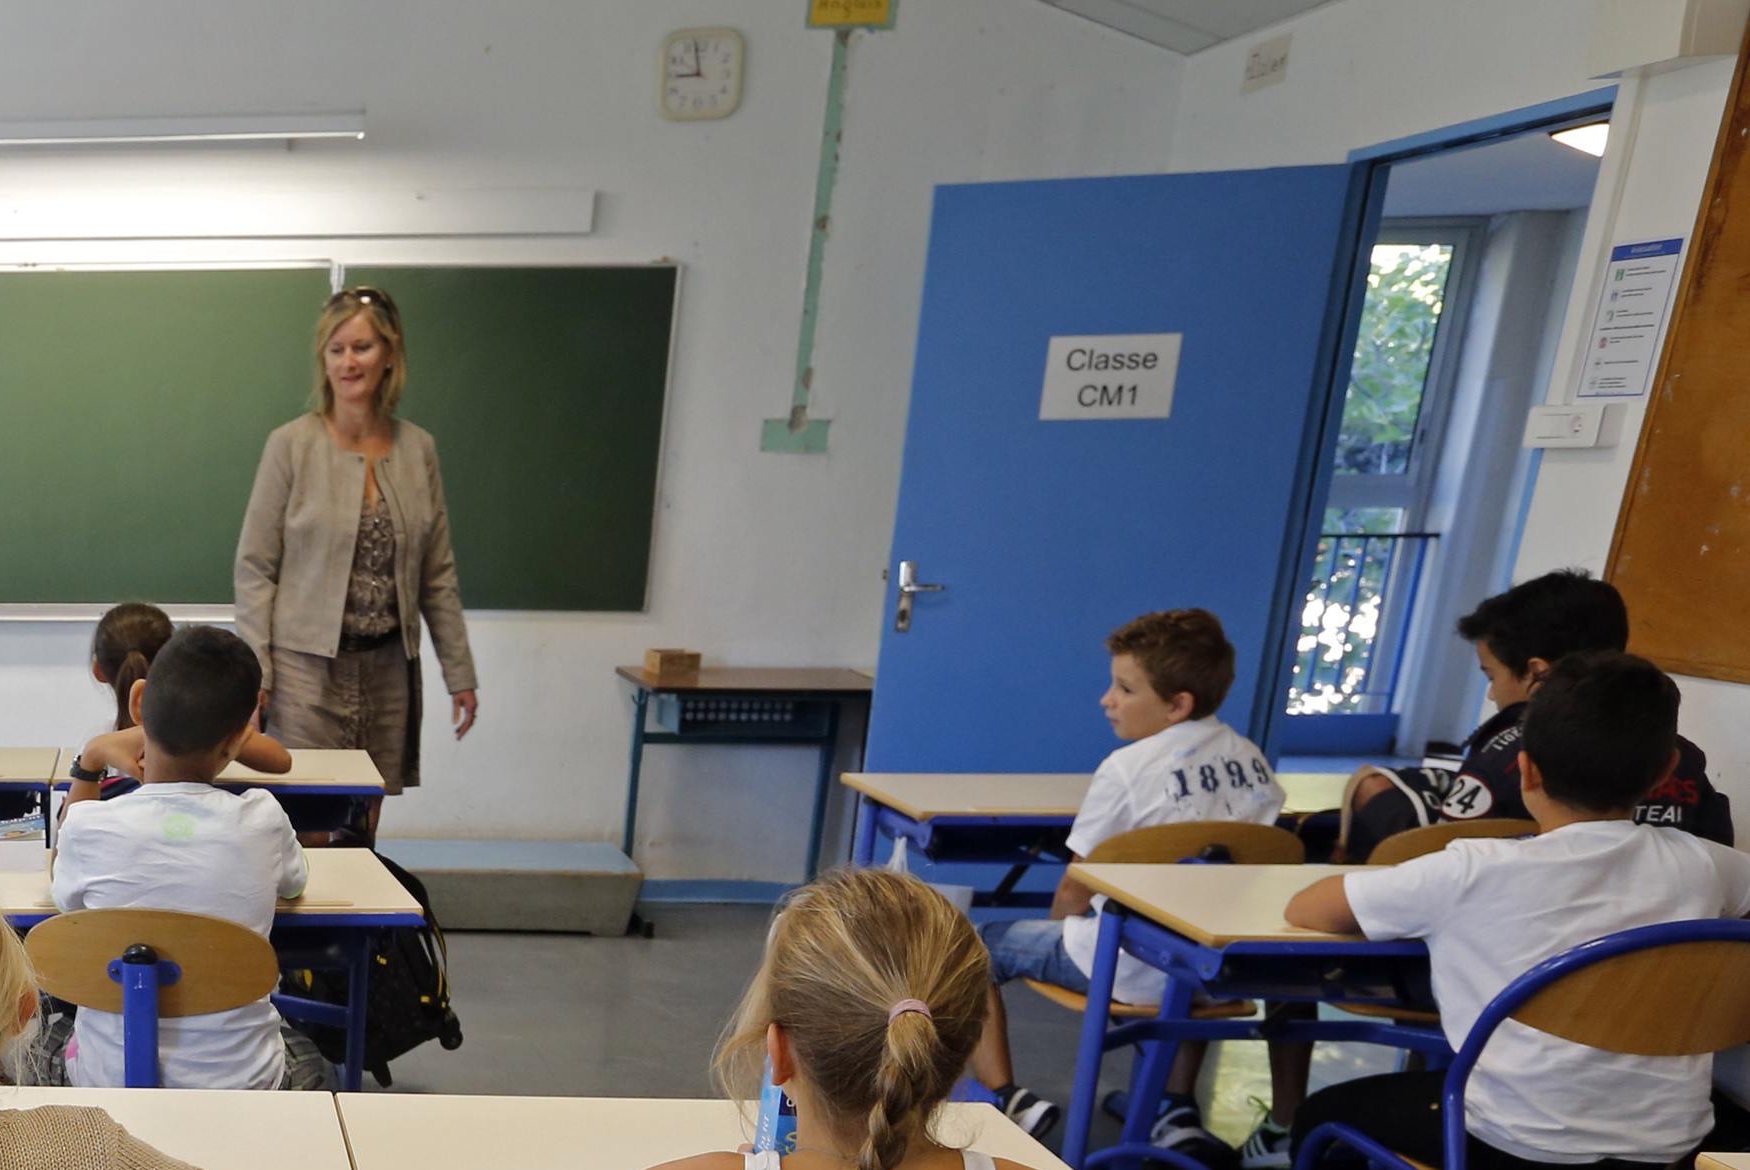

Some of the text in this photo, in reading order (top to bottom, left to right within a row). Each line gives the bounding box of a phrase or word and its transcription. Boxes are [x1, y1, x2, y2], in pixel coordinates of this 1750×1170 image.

[1066, 348, 1158, 372] Classe
[1077, 384, 1138, 408] CM1
[1171, 757, 1269, 798] 1899
[1445, 778, 1482, 815] 24
